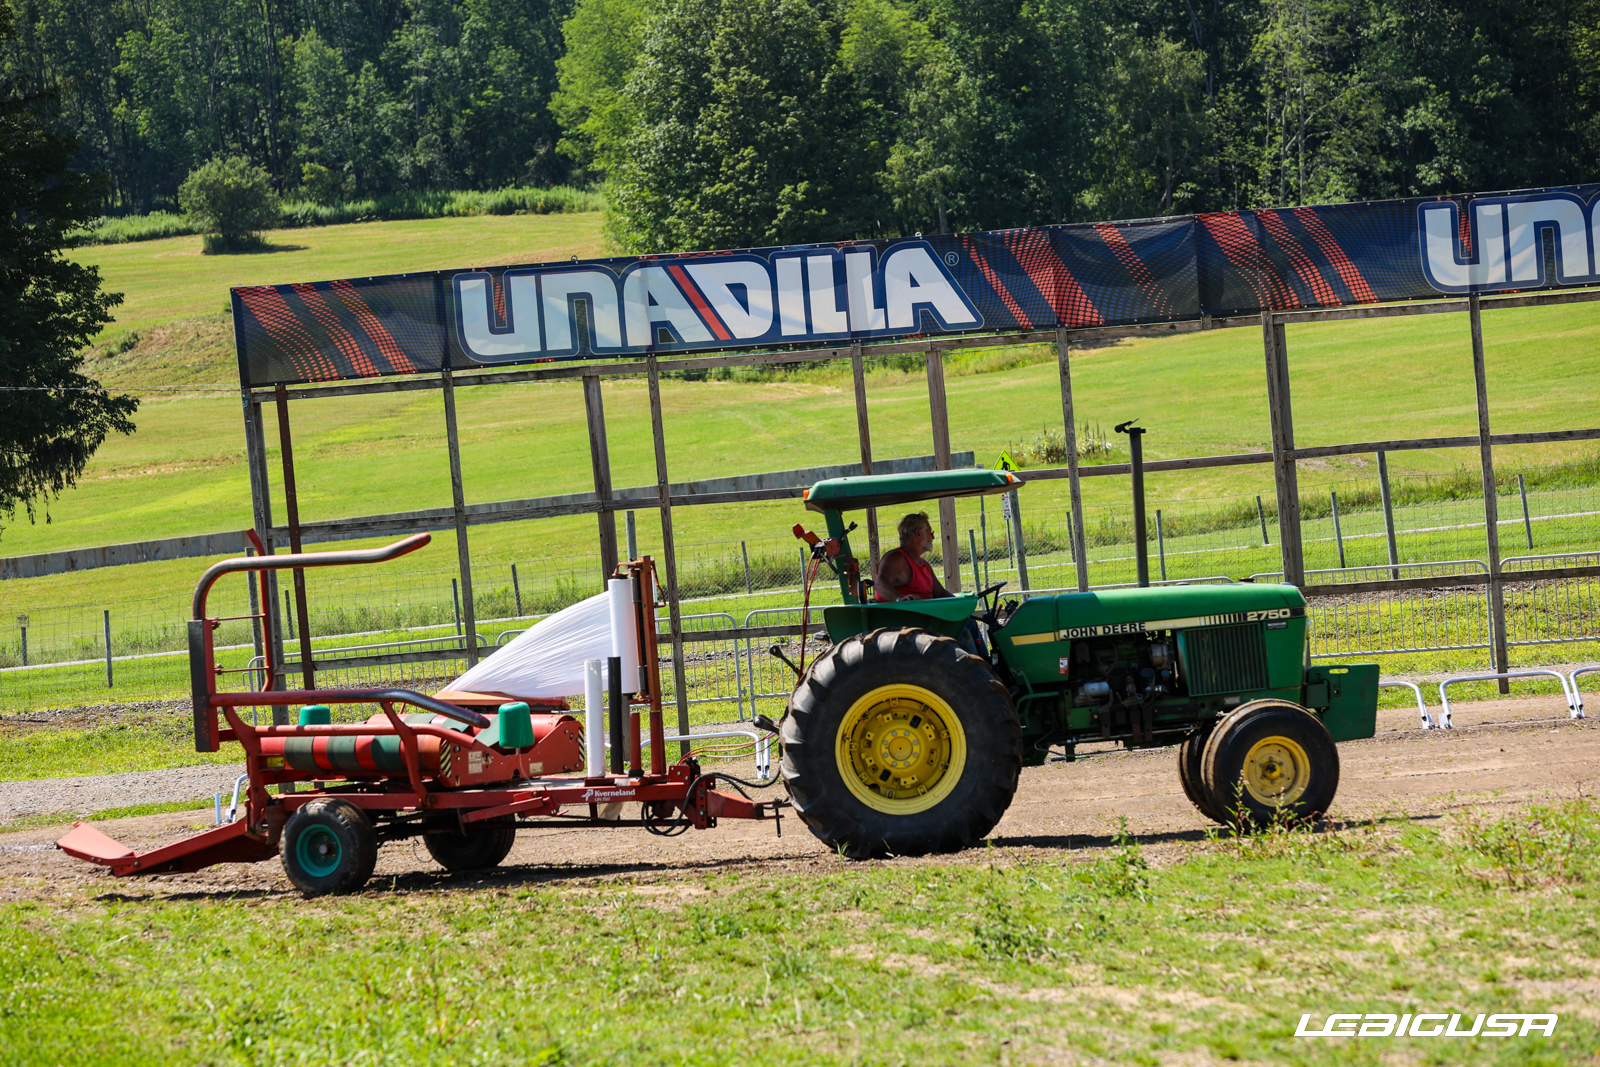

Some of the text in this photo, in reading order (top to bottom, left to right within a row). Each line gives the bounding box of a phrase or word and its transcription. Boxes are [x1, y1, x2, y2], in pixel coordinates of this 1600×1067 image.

[1423, 197, 1600, 288] UN
[458, 245, 980, 357] UNADILLA
[1246, 608, 1291, 622] 2750
[1063, 622, 1146, 639] JOHN DEERE
[594, 788, 636, 798] Kverneland
